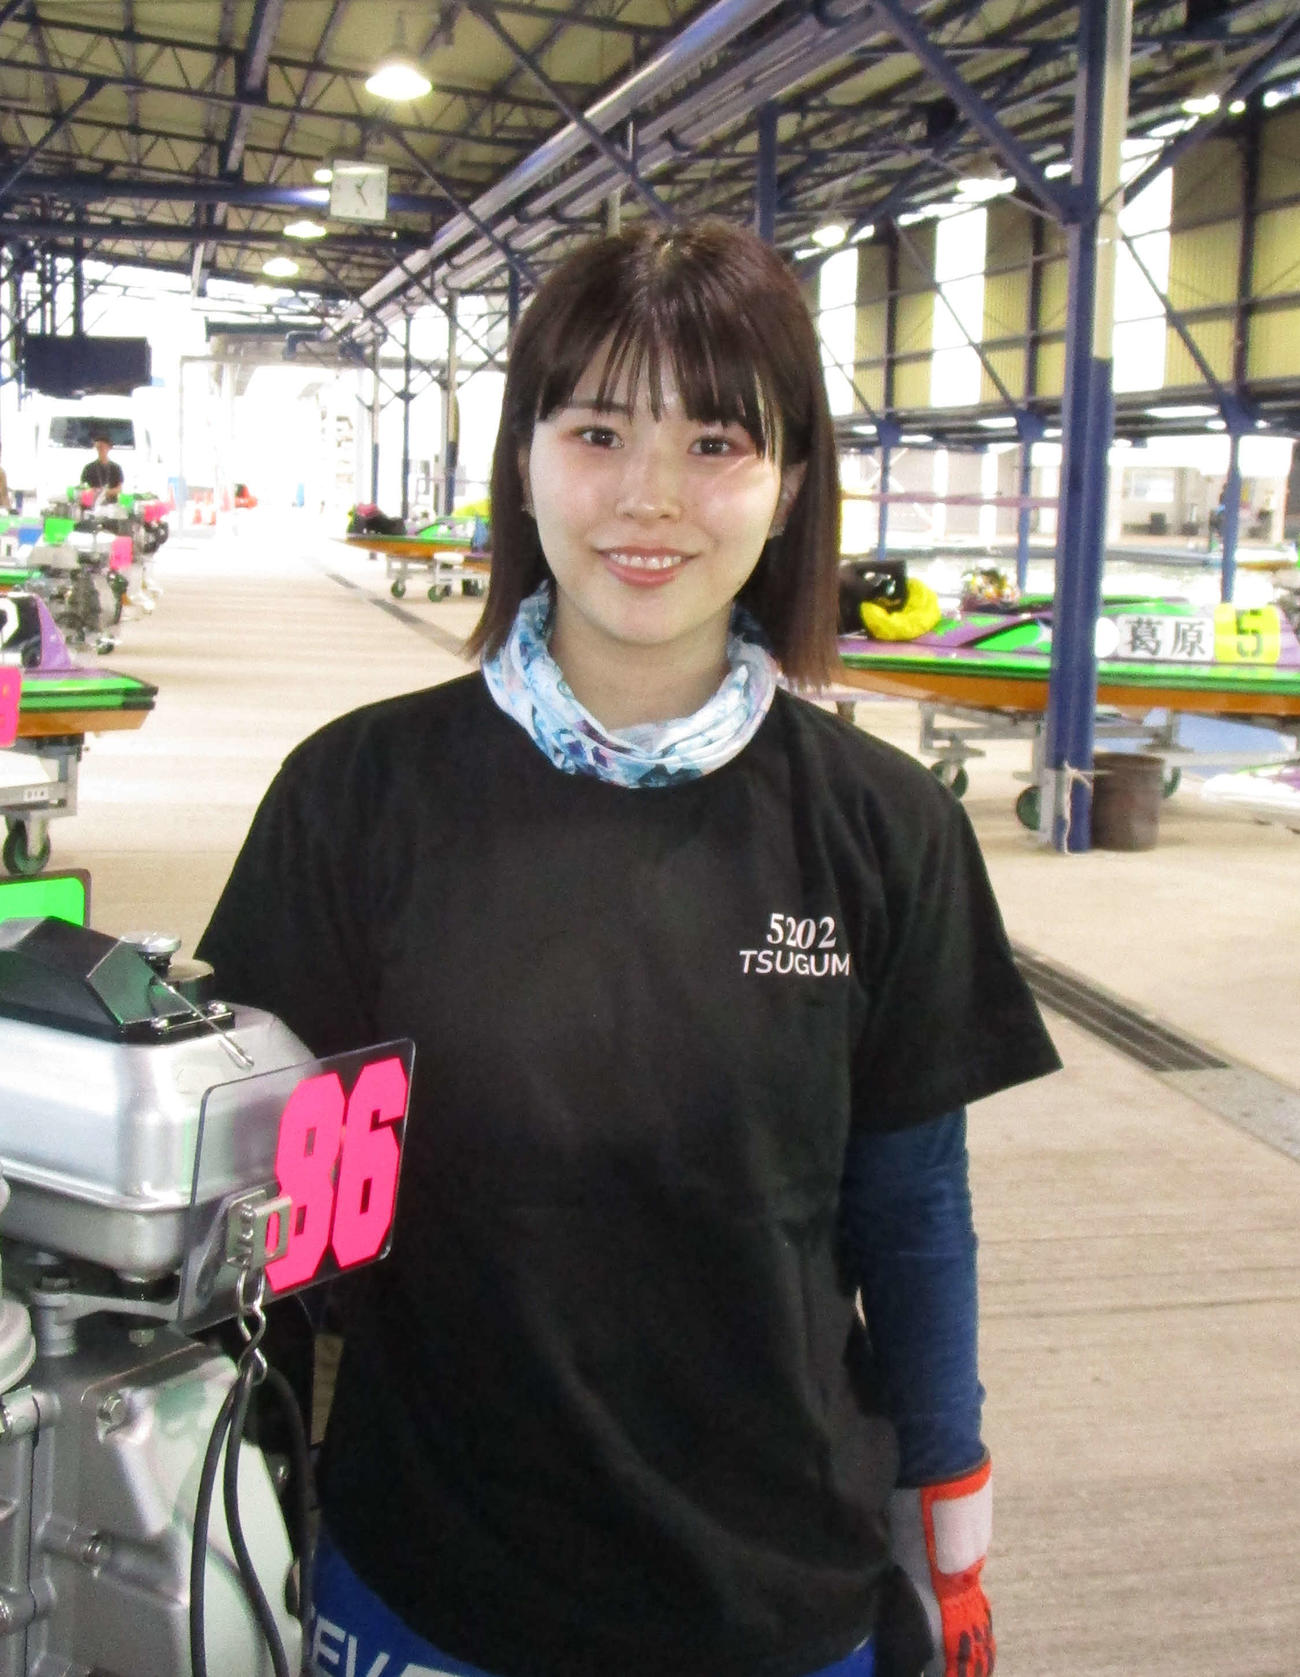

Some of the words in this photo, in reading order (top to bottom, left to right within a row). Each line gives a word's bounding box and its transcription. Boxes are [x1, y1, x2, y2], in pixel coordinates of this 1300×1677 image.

[1125, 616, 1206, 657] 葛原
[1235, 608, 1264, 658] 5
[766, 912, 837, 949] 5202
[264, 1056, 409, 1294] 86
